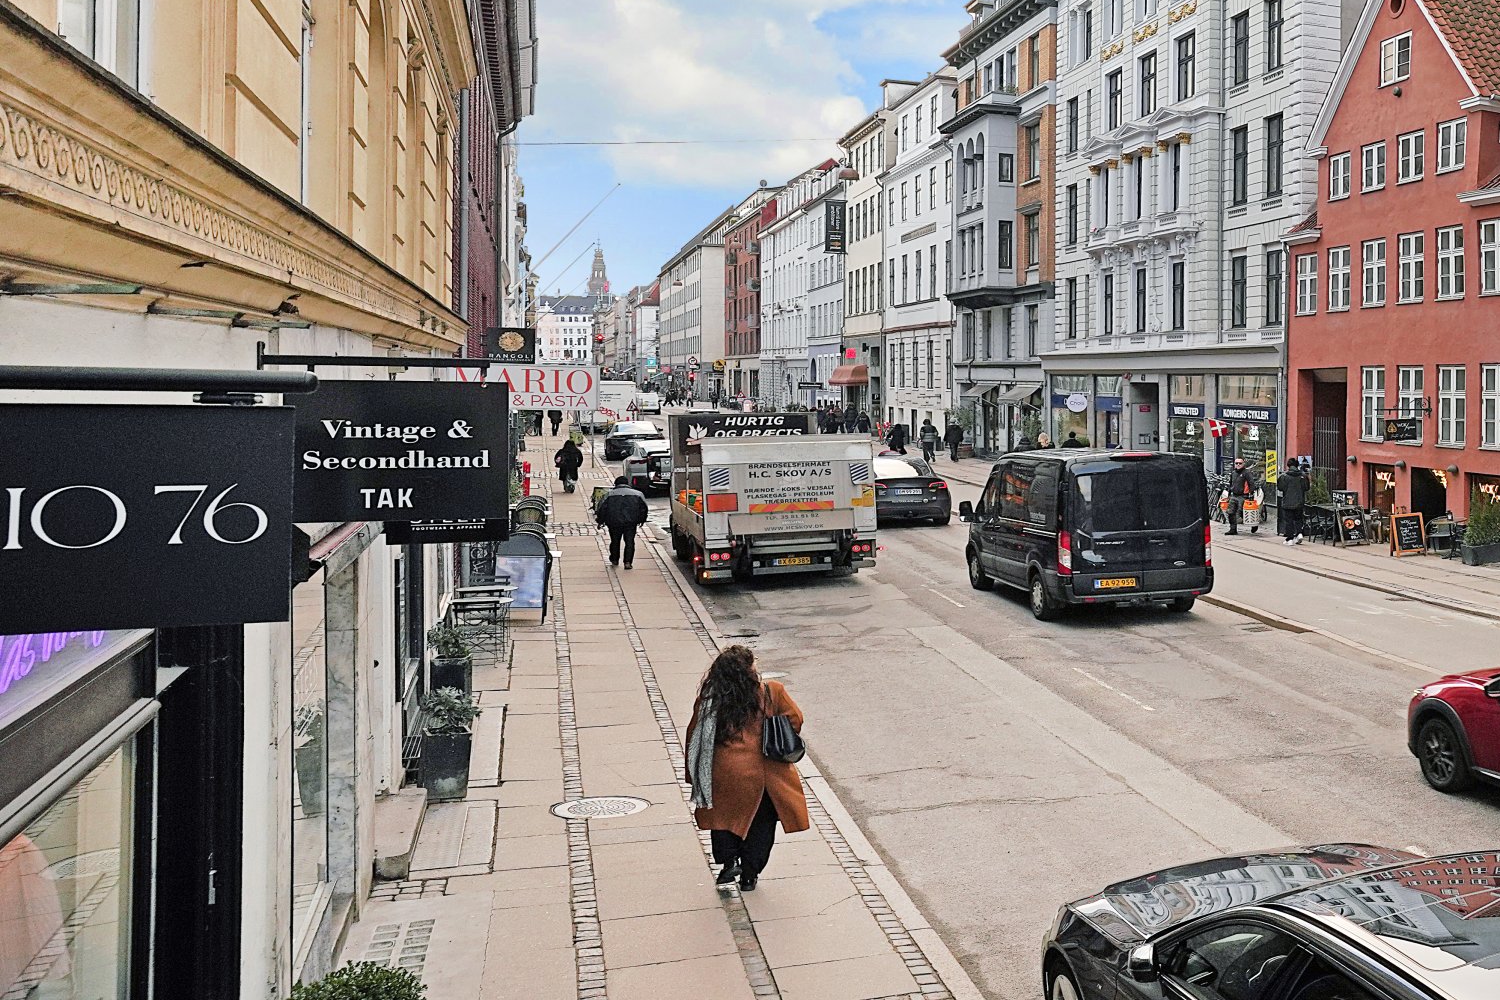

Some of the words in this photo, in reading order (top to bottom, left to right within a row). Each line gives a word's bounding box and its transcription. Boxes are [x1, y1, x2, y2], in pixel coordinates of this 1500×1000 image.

[512, 395, 524, 406] &
[531, 395, 588, 407] PASTA
[1222, 409, 1247, 419] KONGENS
[1247, 410, 1269, 420] CYKLER
[725, 416, 784, 426] HURTIG
[320, 419, 437, 443] Vintage
[447, 419, 473, 439] &
[714, 429, 737, 437] OG
[741, 428, 802, 437] PRÆCIS
[303, 450, 490, 469] Secondhand
[775, 469, 807, 477] SKOV
[810, 468, 832, 477] A/S
[360, 488, 414, 508] TAK
[154, 483, 268, 545] 76
